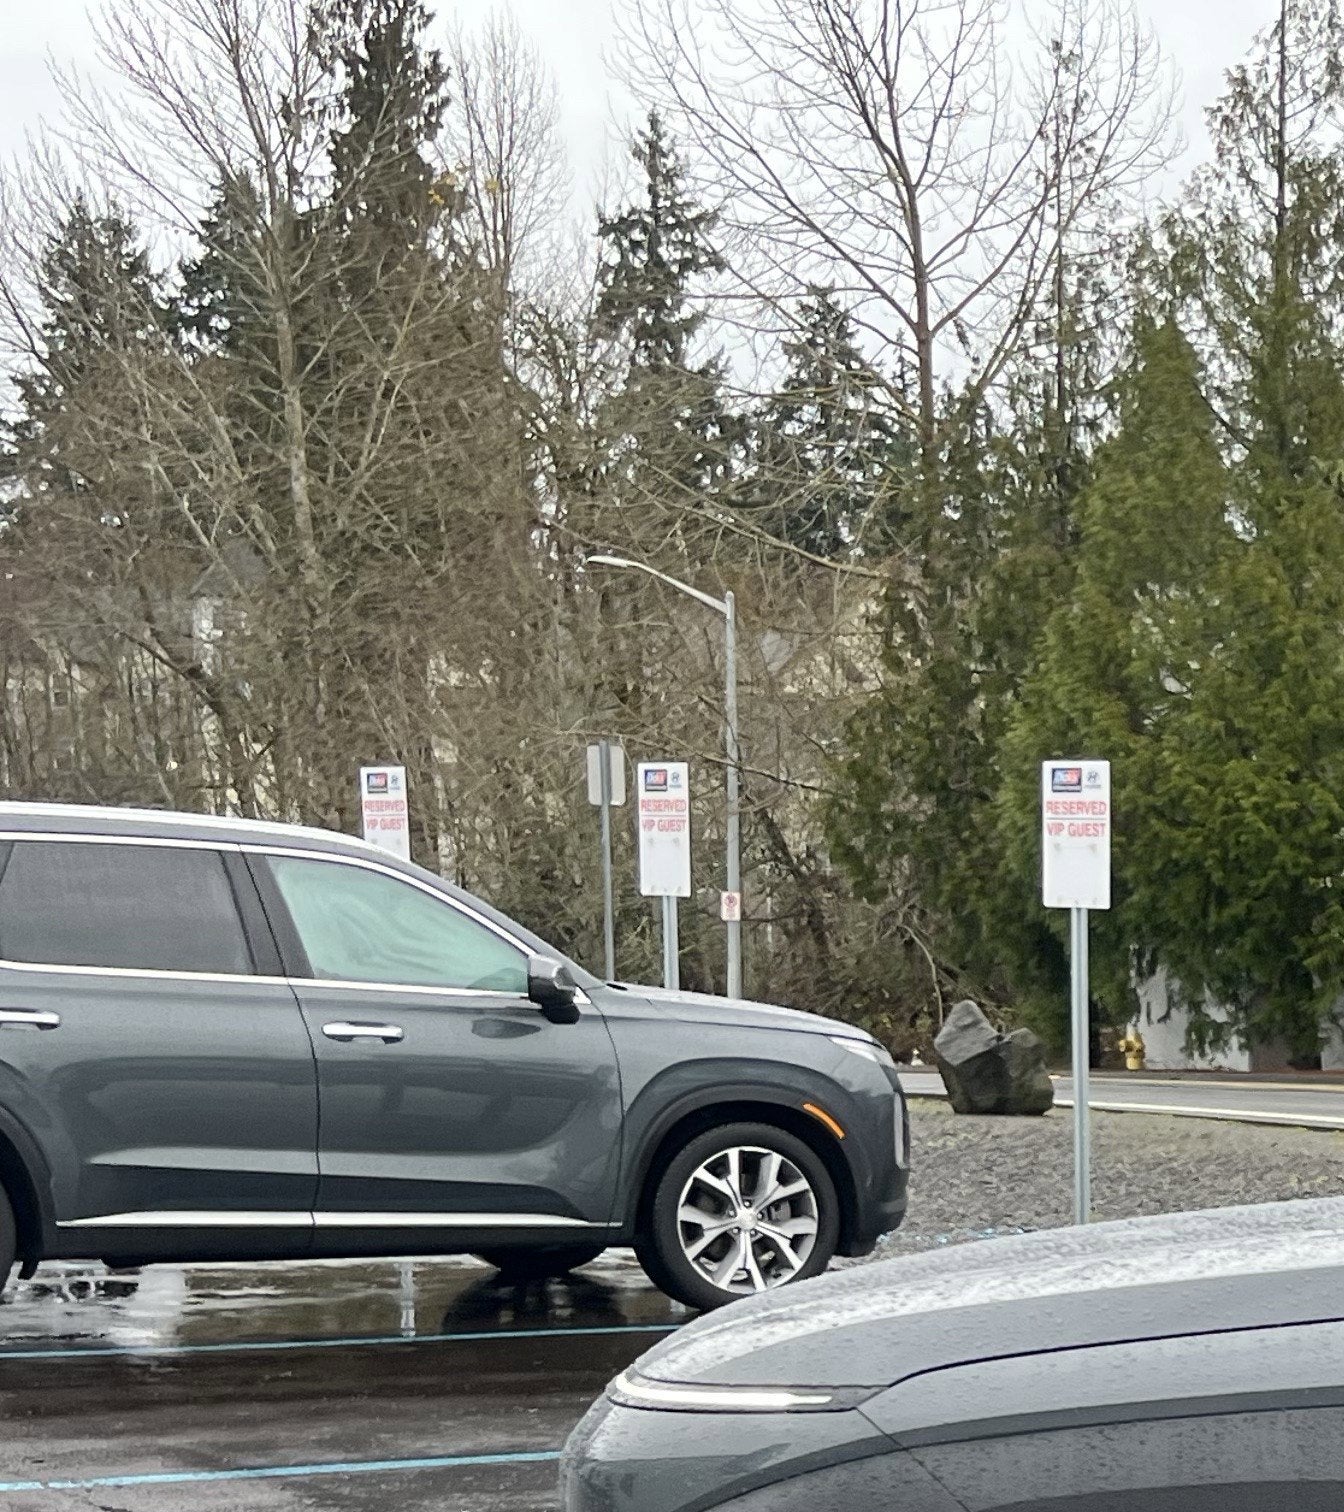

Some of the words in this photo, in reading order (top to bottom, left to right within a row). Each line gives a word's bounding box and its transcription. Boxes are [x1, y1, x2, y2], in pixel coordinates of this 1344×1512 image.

[364, 799, 405, 812] RESERVED
[641, 799, 687, 812] RESERVED
[1046, 801, 1107, 815] RESERVED
[366, 818, 378, 830] VIP
[380, 818, 406, 830] GUEST
[642, 819, 655, 832] VIP
[658, 819, 687, 832] GUEST
[1047, 823, 1064, 837] VIP
[1068, 823, 1106, 837] GUEST
